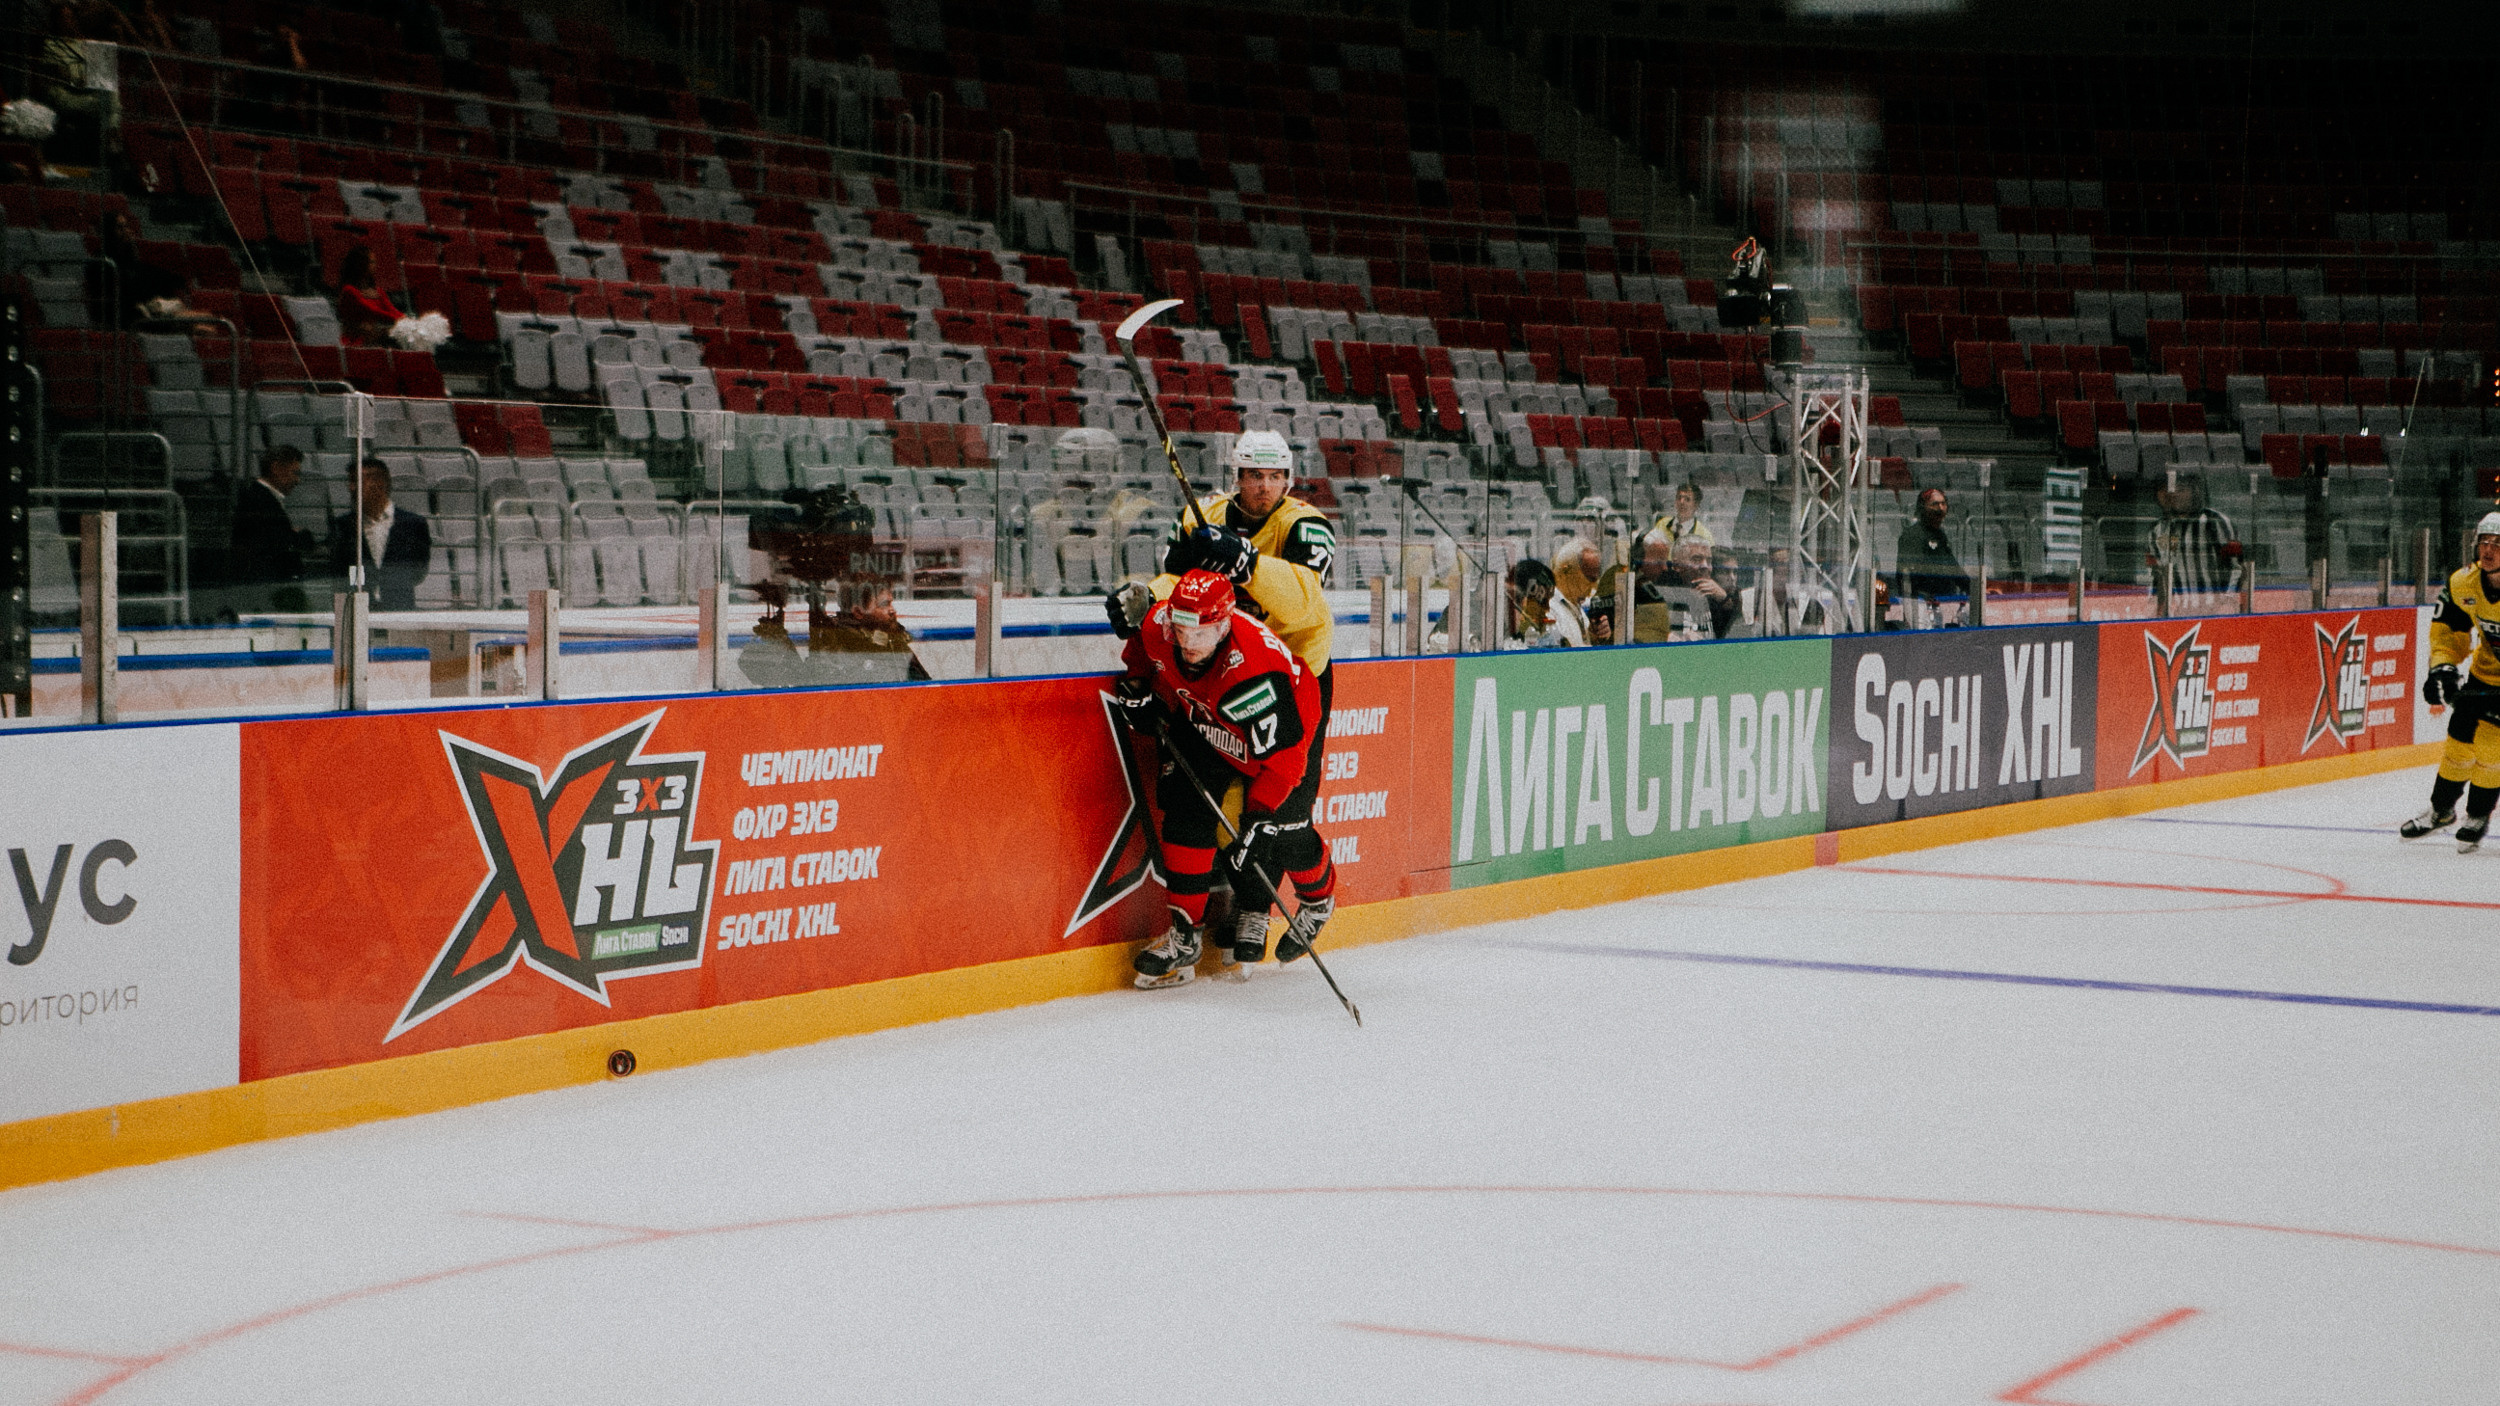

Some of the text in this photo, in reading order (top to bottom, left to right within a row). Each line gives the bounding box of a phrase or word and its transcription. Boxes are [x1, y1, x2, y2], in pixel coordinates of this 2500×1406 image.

[1194, 723, 1243, 757] СНОДАР
[1251, 713, 1278, 754] 17
[1325, 707, 1389, 737] ПИОНАТ
[1852, 641, 2081, 804] SOCHI XHL
[741, 745, 883, 787] ЧЕМПИОНАТ
[613, 775, 688, 815] 3X3
[1326, 791, 1389, 823] СТАВОК
[733, 806, 788, 841] ФХР
[1331, 836, 1361, 864] XHL
[724, 846, 882, 896] ЛИГА СТАВОК
[717, 903, 840, 950] SOCHI XHL
